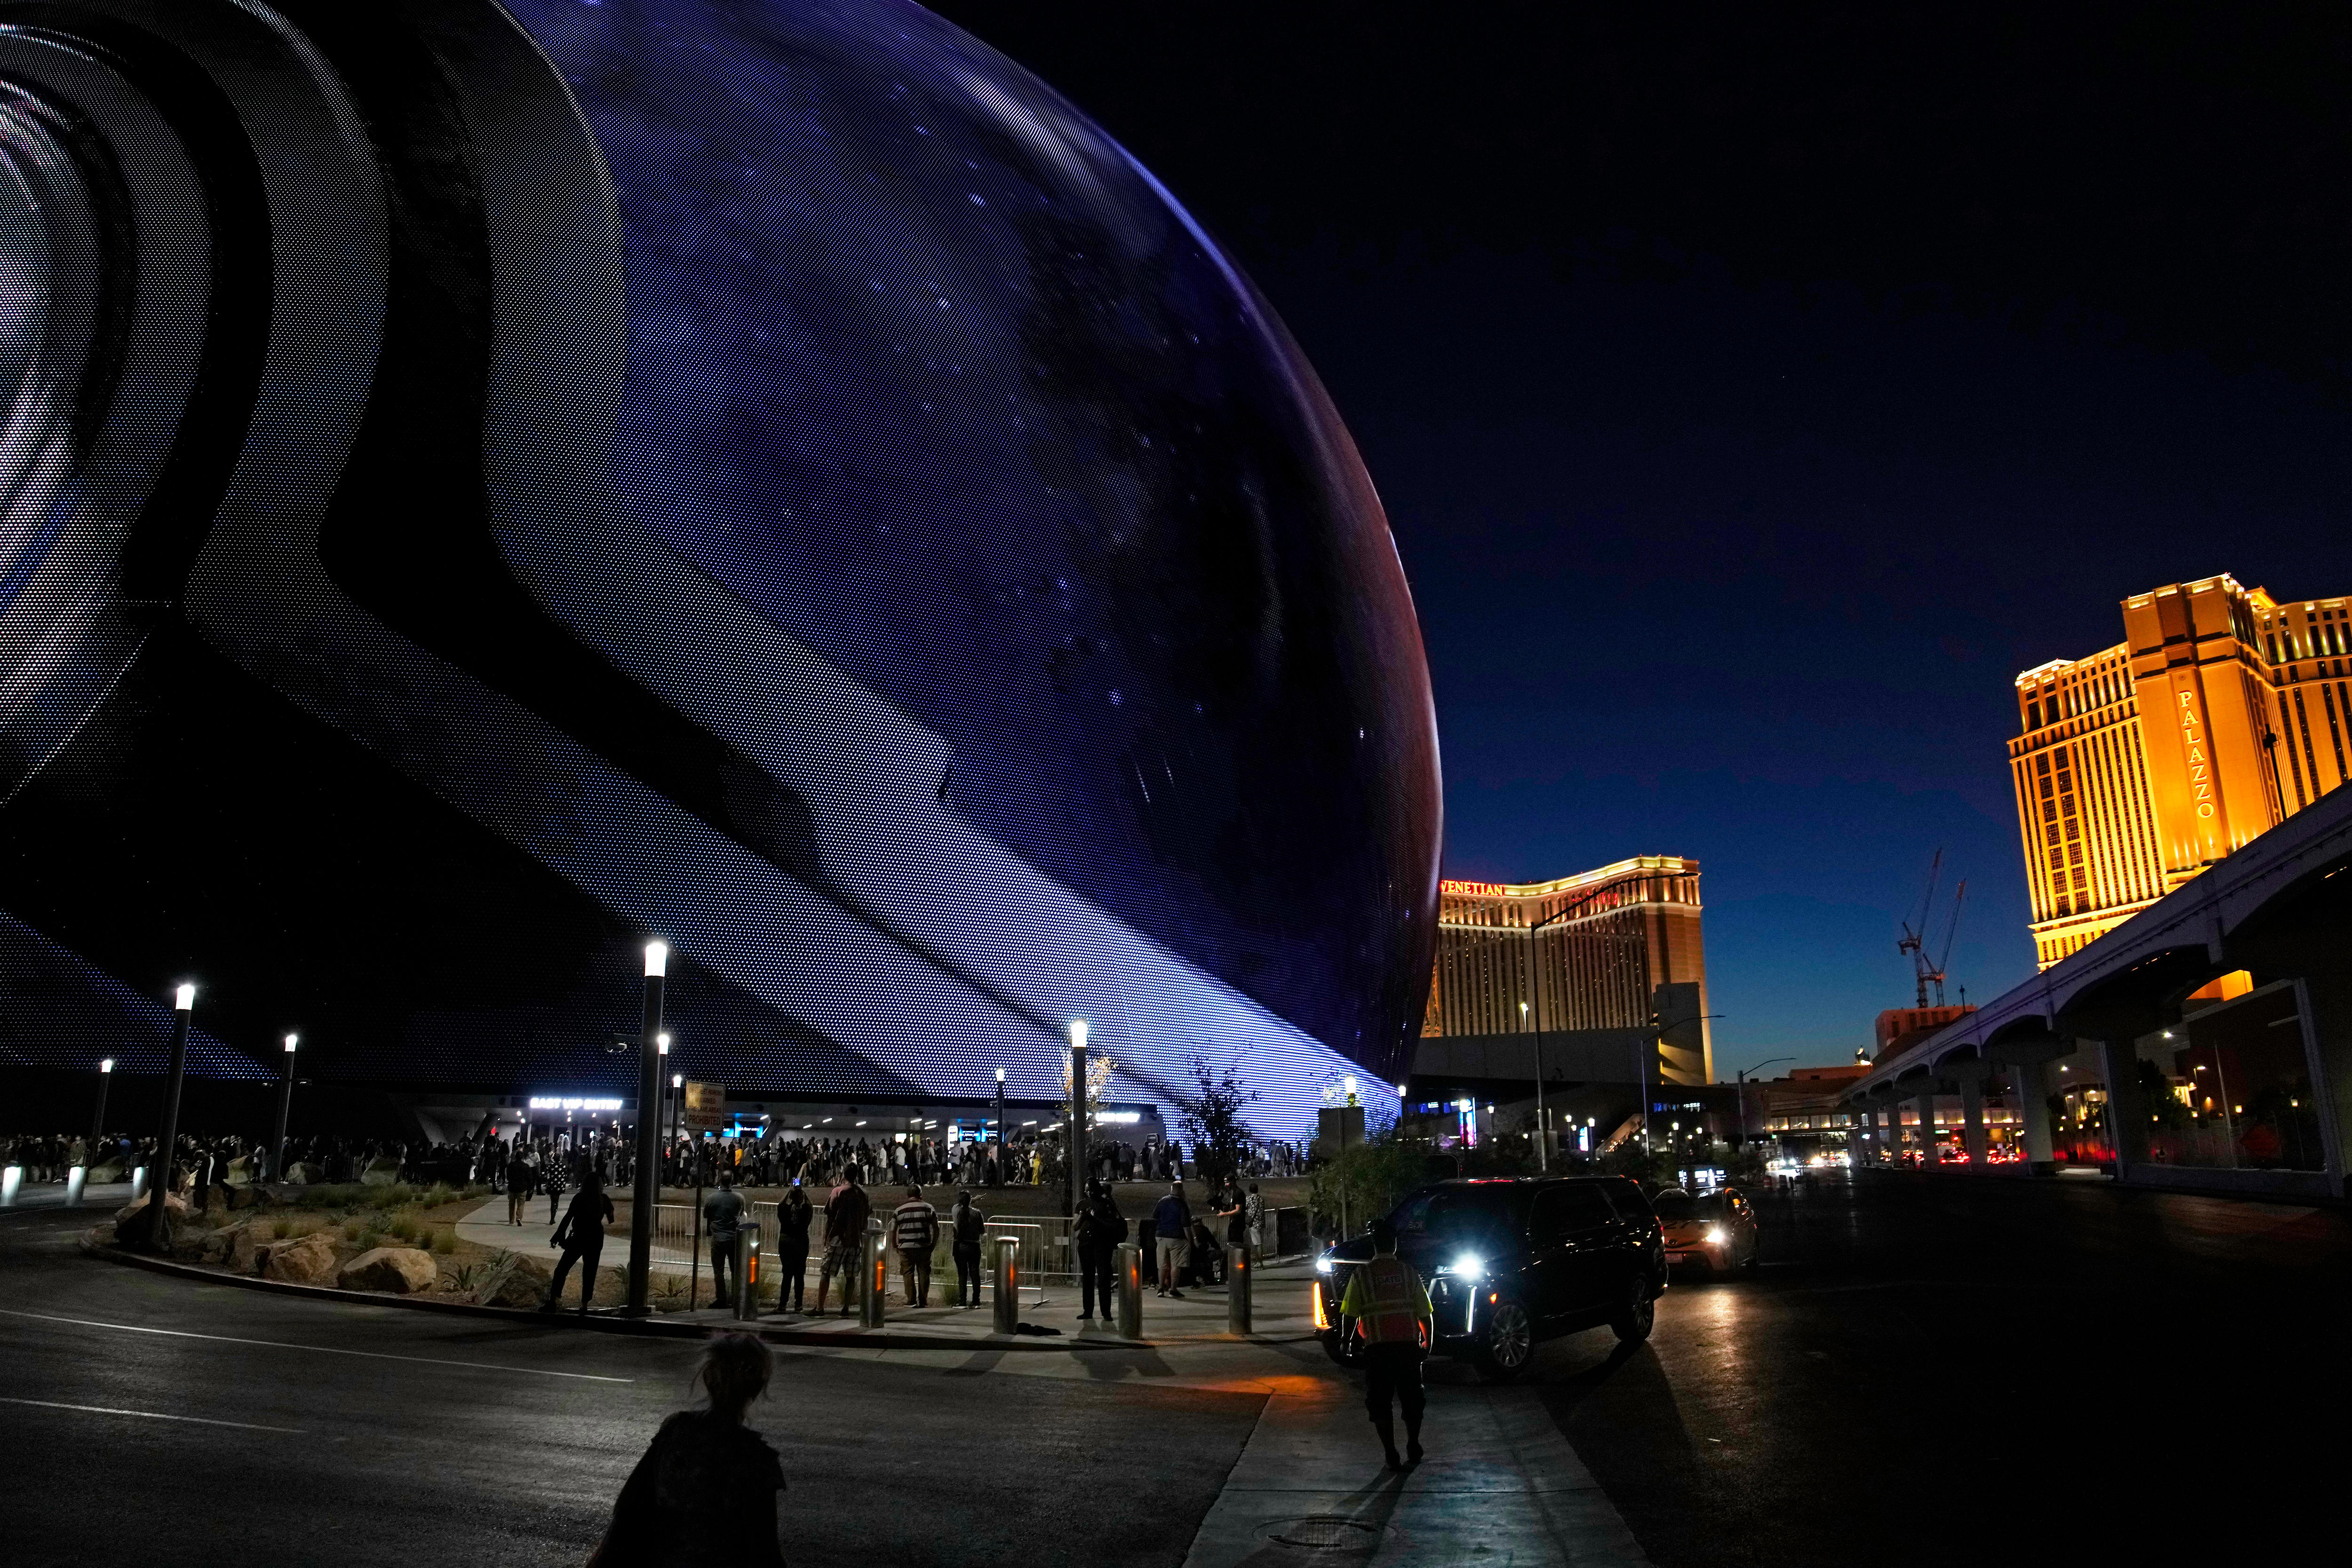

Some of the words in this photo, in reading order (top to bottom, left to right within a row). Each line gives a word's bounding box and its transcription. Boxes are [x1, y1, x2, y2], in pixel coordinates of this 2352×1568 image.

[2179, 690, 2214, 818] PALAZZO
[1441, 880, 1503, 897] VENETIAN
[530, 1098, 562, 1108] EAST
[563, 1098, 583, 1109] VIP
[584, 1099, 623, 1109] ENTRY
[689, 1114, 721, 1125] PROHIBITED
